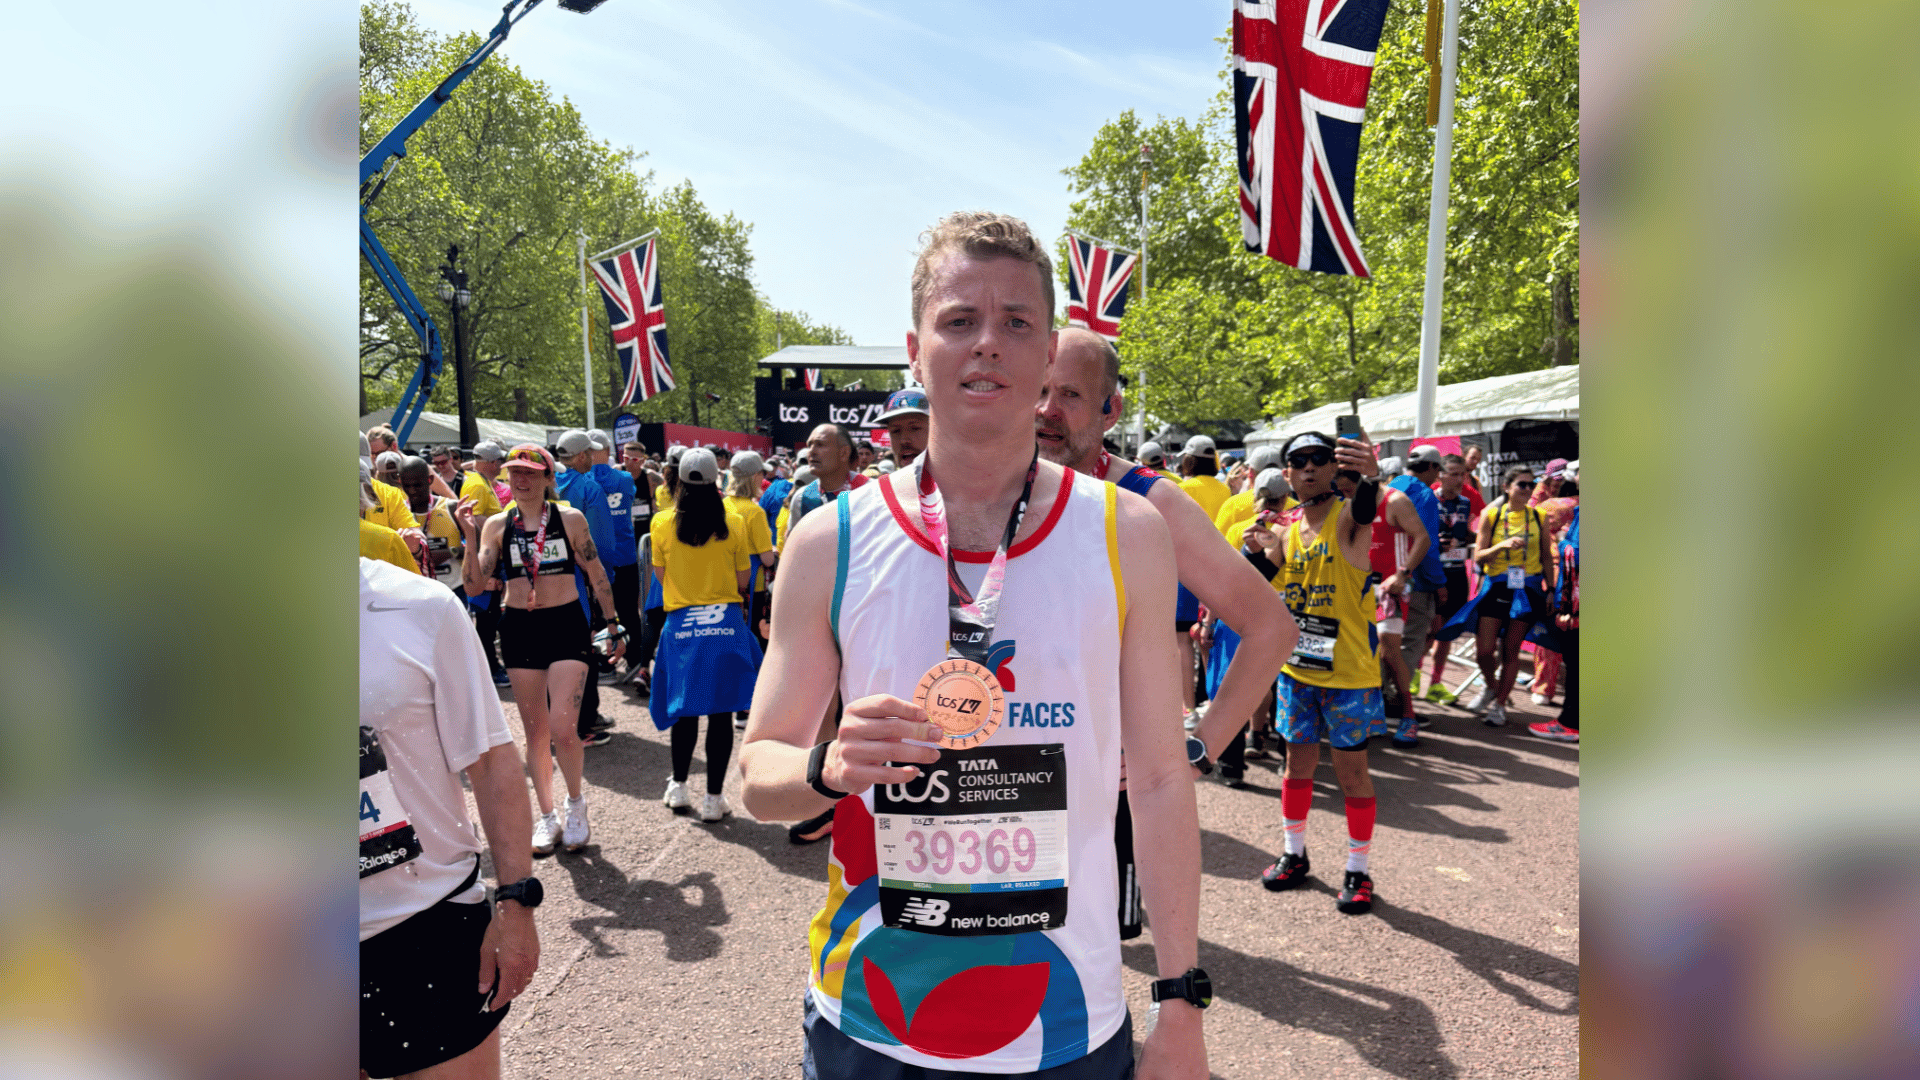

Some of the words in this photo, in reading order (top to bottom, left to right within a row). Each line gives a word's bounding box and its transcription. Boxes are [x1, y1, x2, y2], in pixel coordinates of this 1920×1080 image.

[779, 403, 809, 422] tcs
[829, 404, 859, 423] tcs
[1487, 451, 1519, 463] TATA
[674, 631, 692, 639] new
[694, 627, 735, 637] balance
[952, 632, 968, 642] tcs
[937, 694, 957, 708] tcs
[1009, 702, 1075, 728] FACES
[957, 759, 999, 772] TATA
[958, 771, 1053, 787] CONSULTANCY
[958, 788, 1019, 803] SERVICES
[904, 827, 1036, 875] 39369
[951, 916, 983, 928] new
[987, 911, 1050, 927] balance
